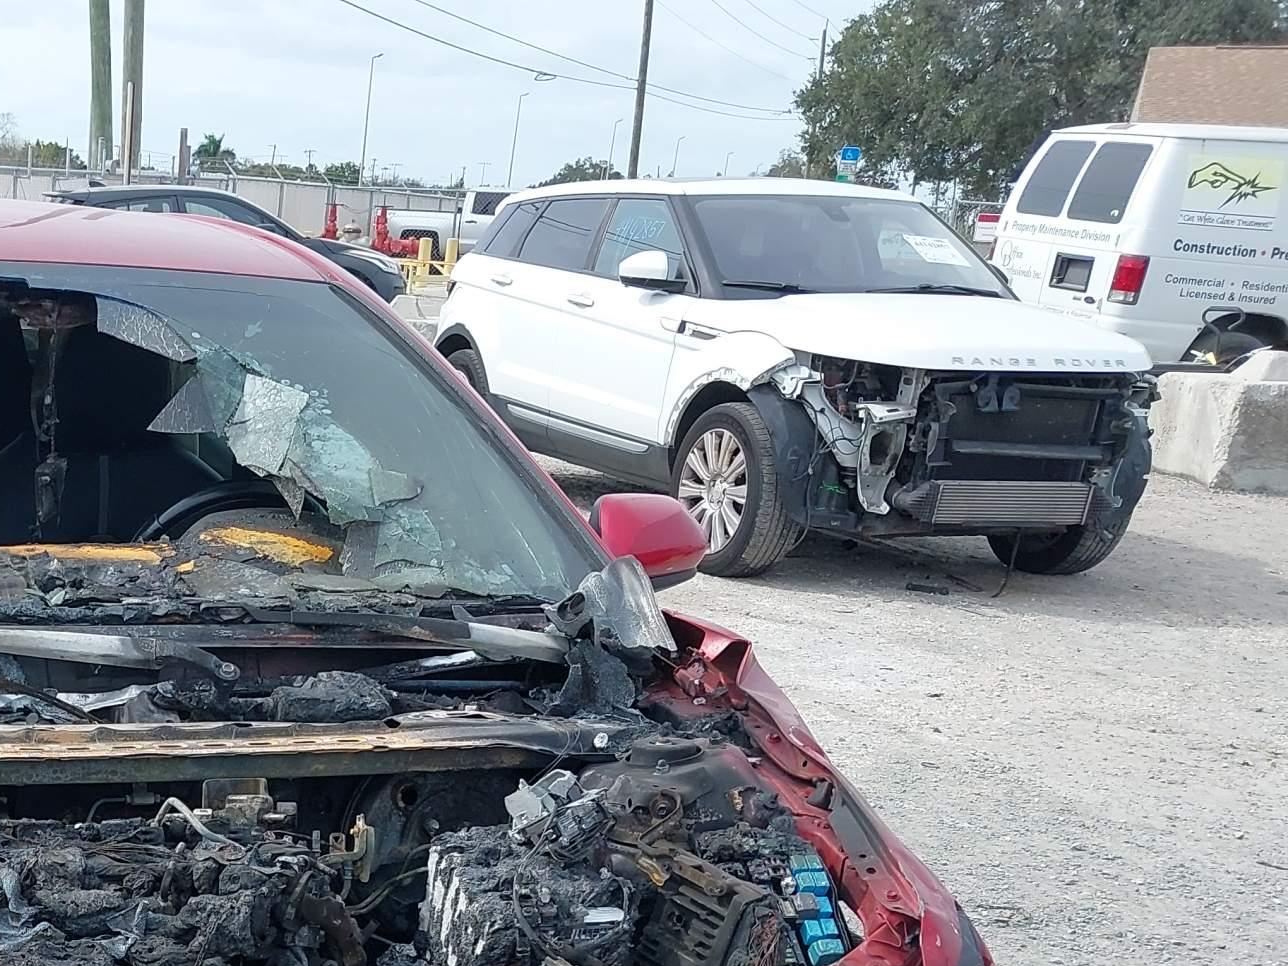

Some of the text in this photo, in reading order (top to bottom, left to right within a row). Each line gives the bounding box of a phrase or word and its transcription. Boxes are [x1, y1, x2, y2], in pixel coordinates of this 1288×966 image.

[1012, 220, 1037, 234] Property
[1038, 223, 1080, 238] Maintenance
[1081, 229, 1111, 242] Division
[1173, 239, 1257, 258] Construction
[1165, 273, 1288, 293] Commercial Residenti
[1179, 288, 1276, 305] Licensed & Insured
[951, 356, 1126, 368] RANGE ROVER
